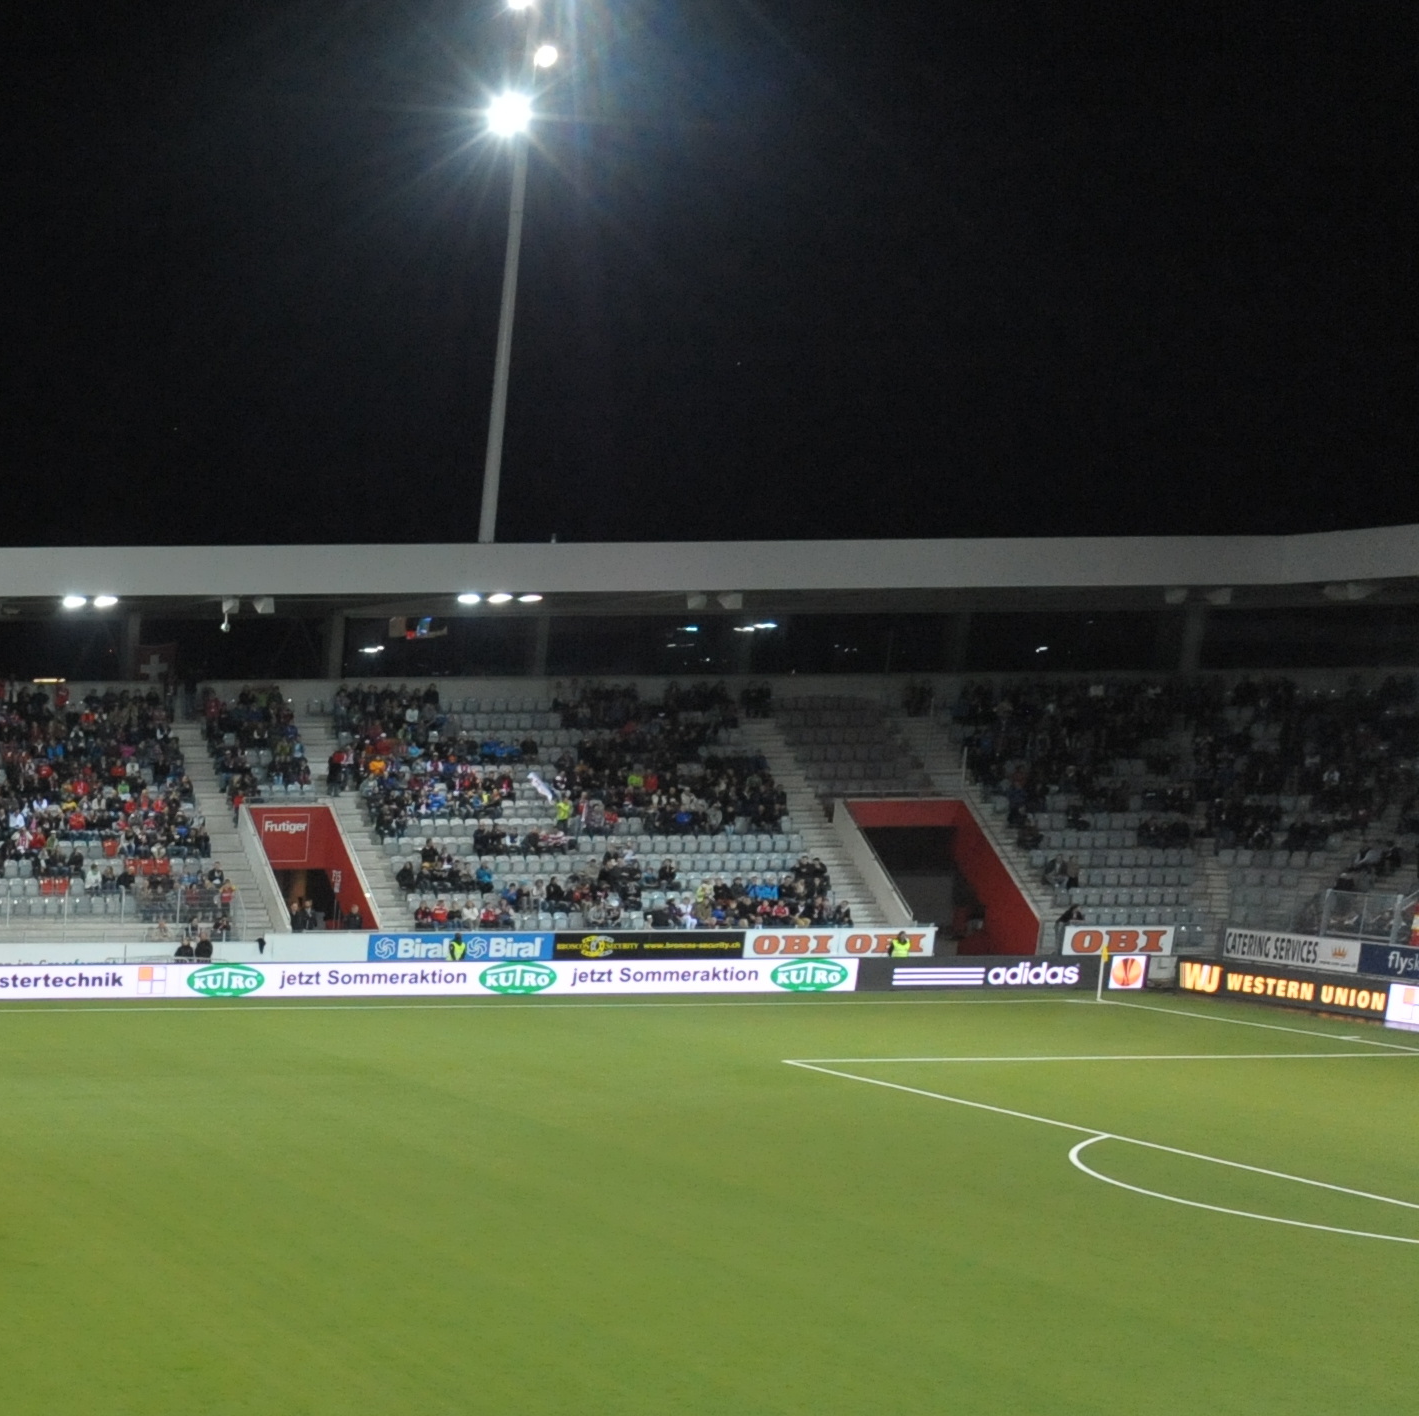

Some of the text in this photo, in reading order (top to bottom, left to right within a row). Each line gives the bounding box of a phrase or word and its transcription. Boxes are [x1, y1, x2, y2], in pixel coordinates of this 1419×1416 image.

[265, 821, 307, 834] Frutiger
[397, 938, 447, 958] Biral
[489, 938, 541, 957] Biral
[753, 935, 833, 955] OBI
[1070, 930, 1167, 953] OBI
[1225, 934, 1318, 964] CATERING SERVICES
[194, 968, 258, 989] KUTRO
[279, 969, 467, 989] jetzt Sommeraktion
[485, 965, 550, 986] KUTRO
[571, 967, 759, 986] jetzt Sommeraktion
[775, 962, 841, 984] KUTRO
[988, 961, 1079, 985] adidas
[1181, 962, 1386, 1011] WU WESTERN UNION
